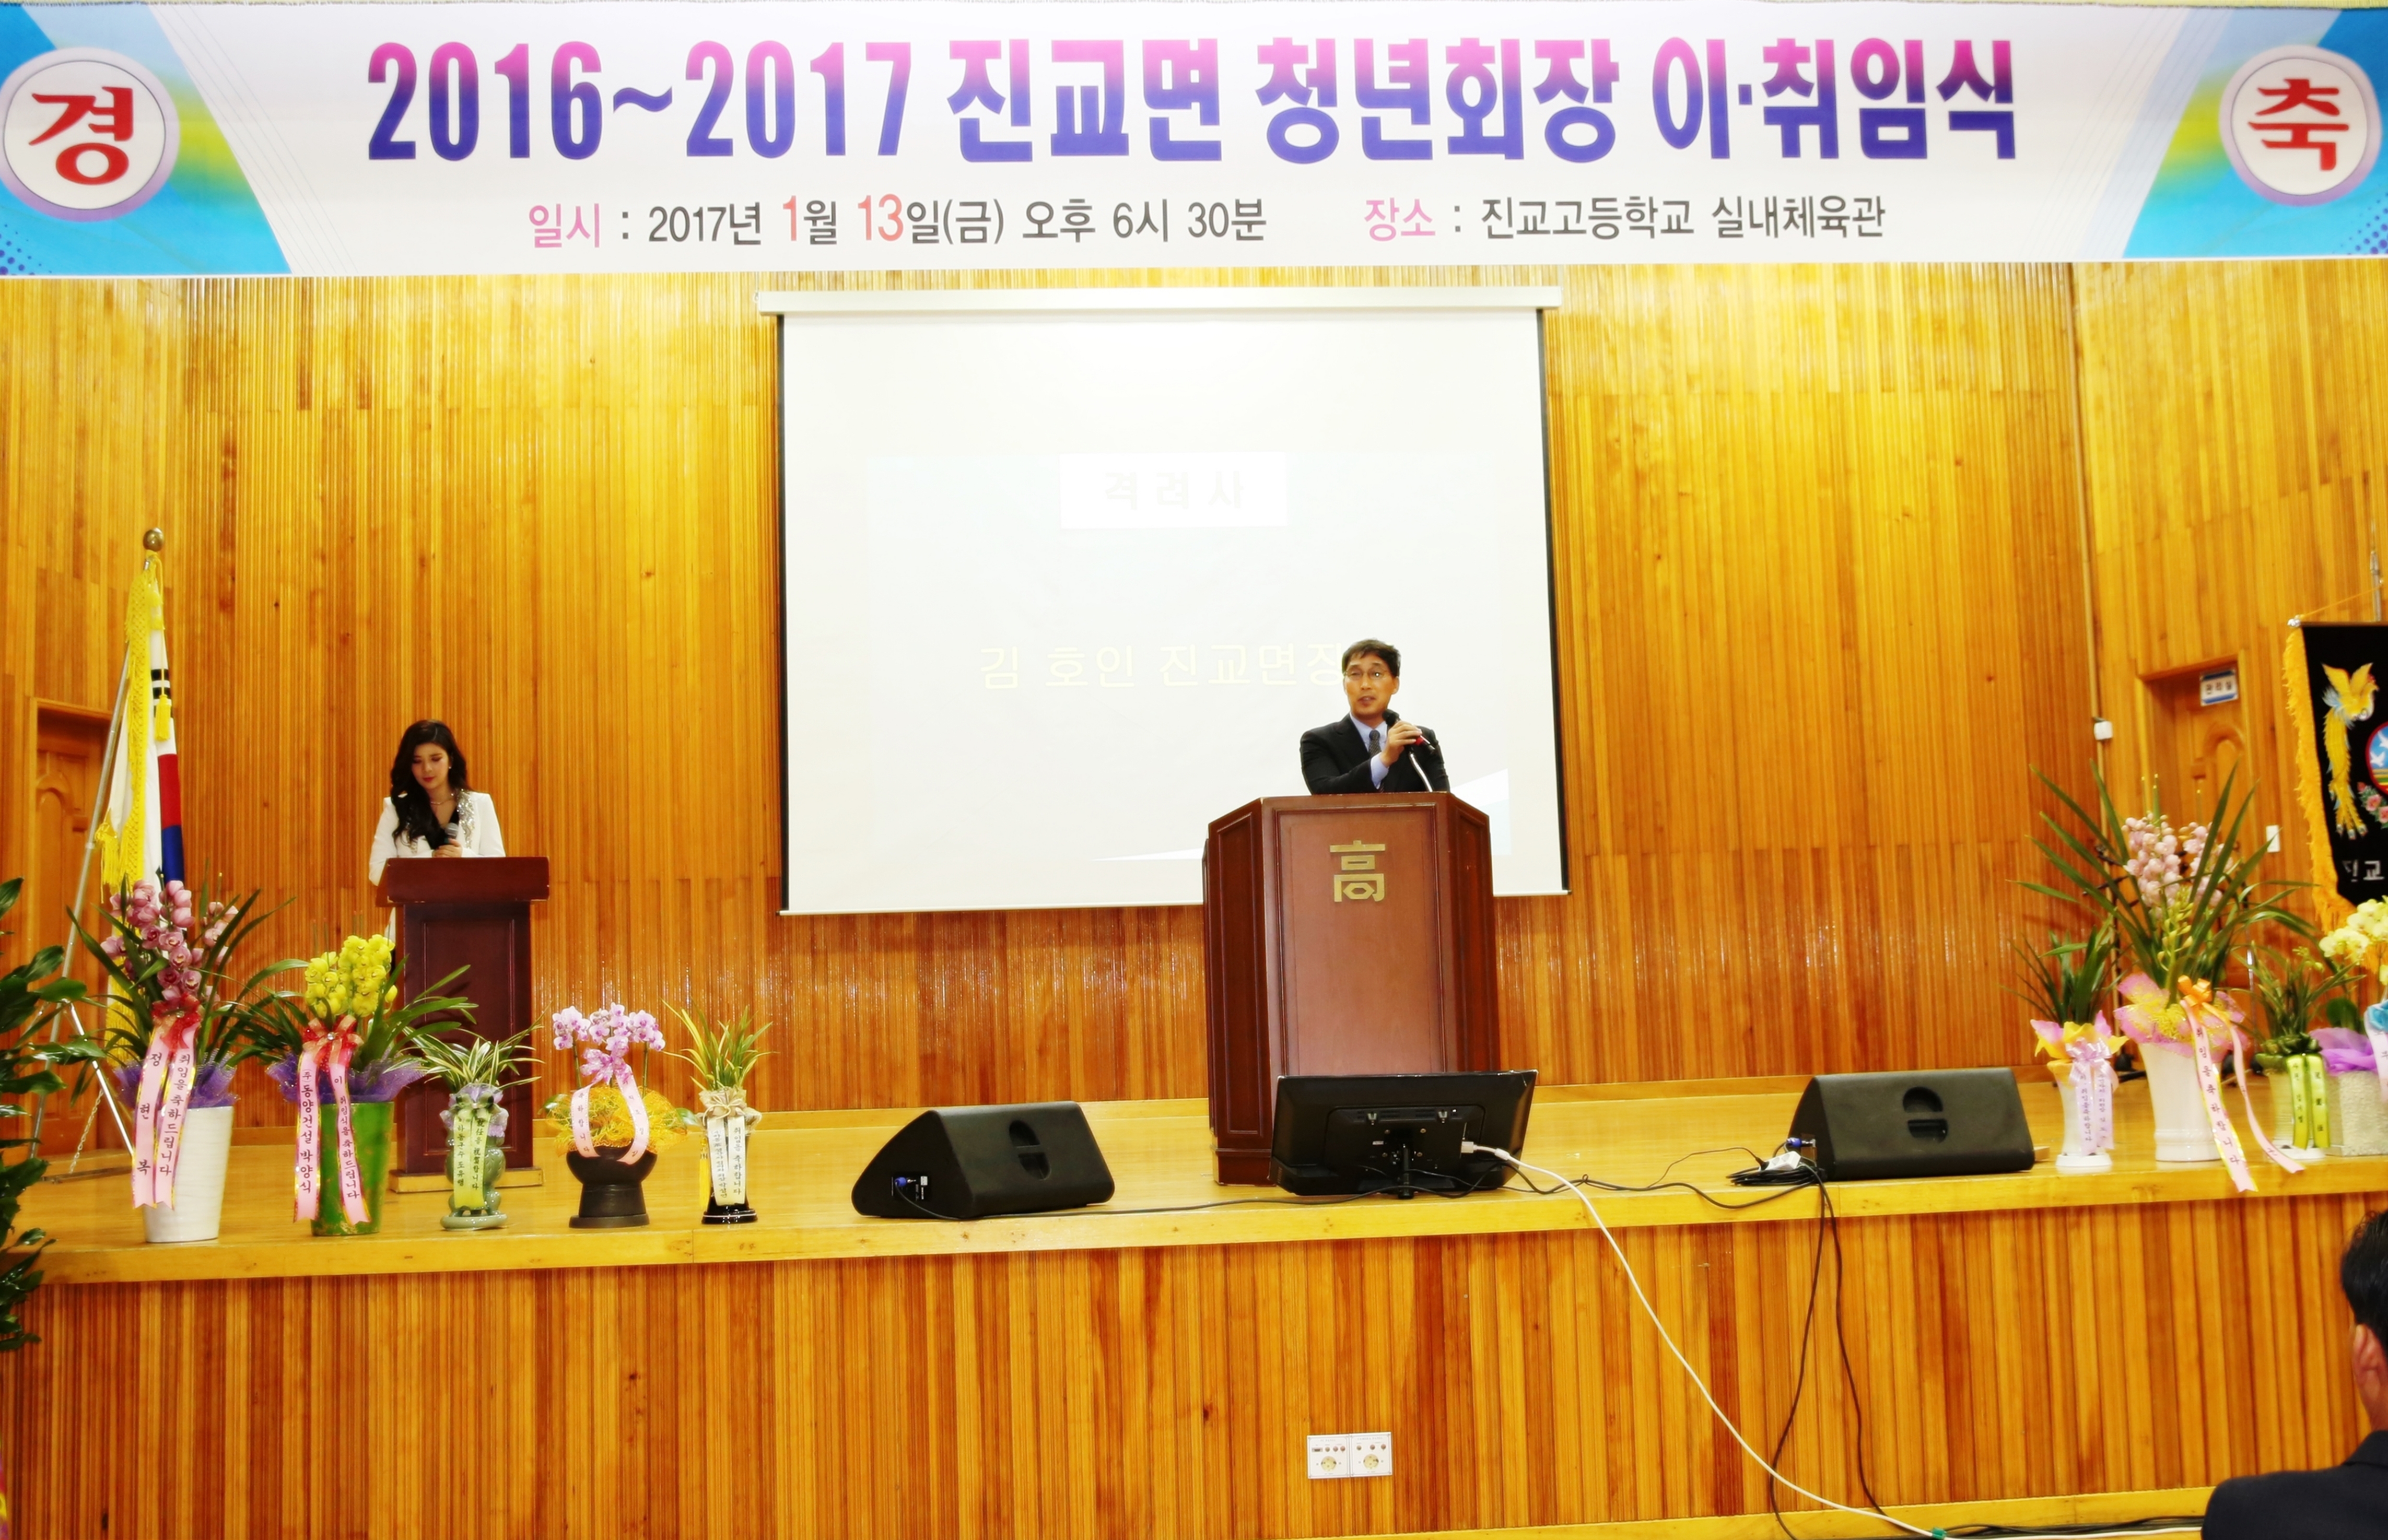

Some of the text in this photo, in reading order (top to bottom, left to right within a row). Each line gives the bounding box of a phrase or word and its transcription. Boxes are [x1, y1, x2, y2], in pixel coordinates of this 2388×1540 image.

[368, 41, 910, 162] 2016~2017
[947, 38, 1222, 162] 진교면
[1256, 38, 1619, 164] 청년회장
[2247, 78, 2350, 171] 축
[29, 86, 134, 185] 경
[529, 203, 600, 249] 일시
[648, 202, 762, 246] 2017년
[782, 195, 838, 245] 1월
[857, 194, 1004, 244] 13일(금)
[1022, 198, 1096, 243] 오후
[1113, 199, 1169, 242] 6시
[1187, 198, 1267, 241] 30분
[1364, 198, 1435, 242] 장소
[1481, 196, 1695, 240] 진교고등학교
[1712, 195, 1886, 239] 실내체육관
[979, 646, 1019, 690] 김
[1045, 644, 1135, 688] 호인
[1329, 839, 1386, 903] 高
[159, 1054, 191, 1176] 취임을 축하드립니다
[342, 1139, 360, 1199] 축하드립니다
